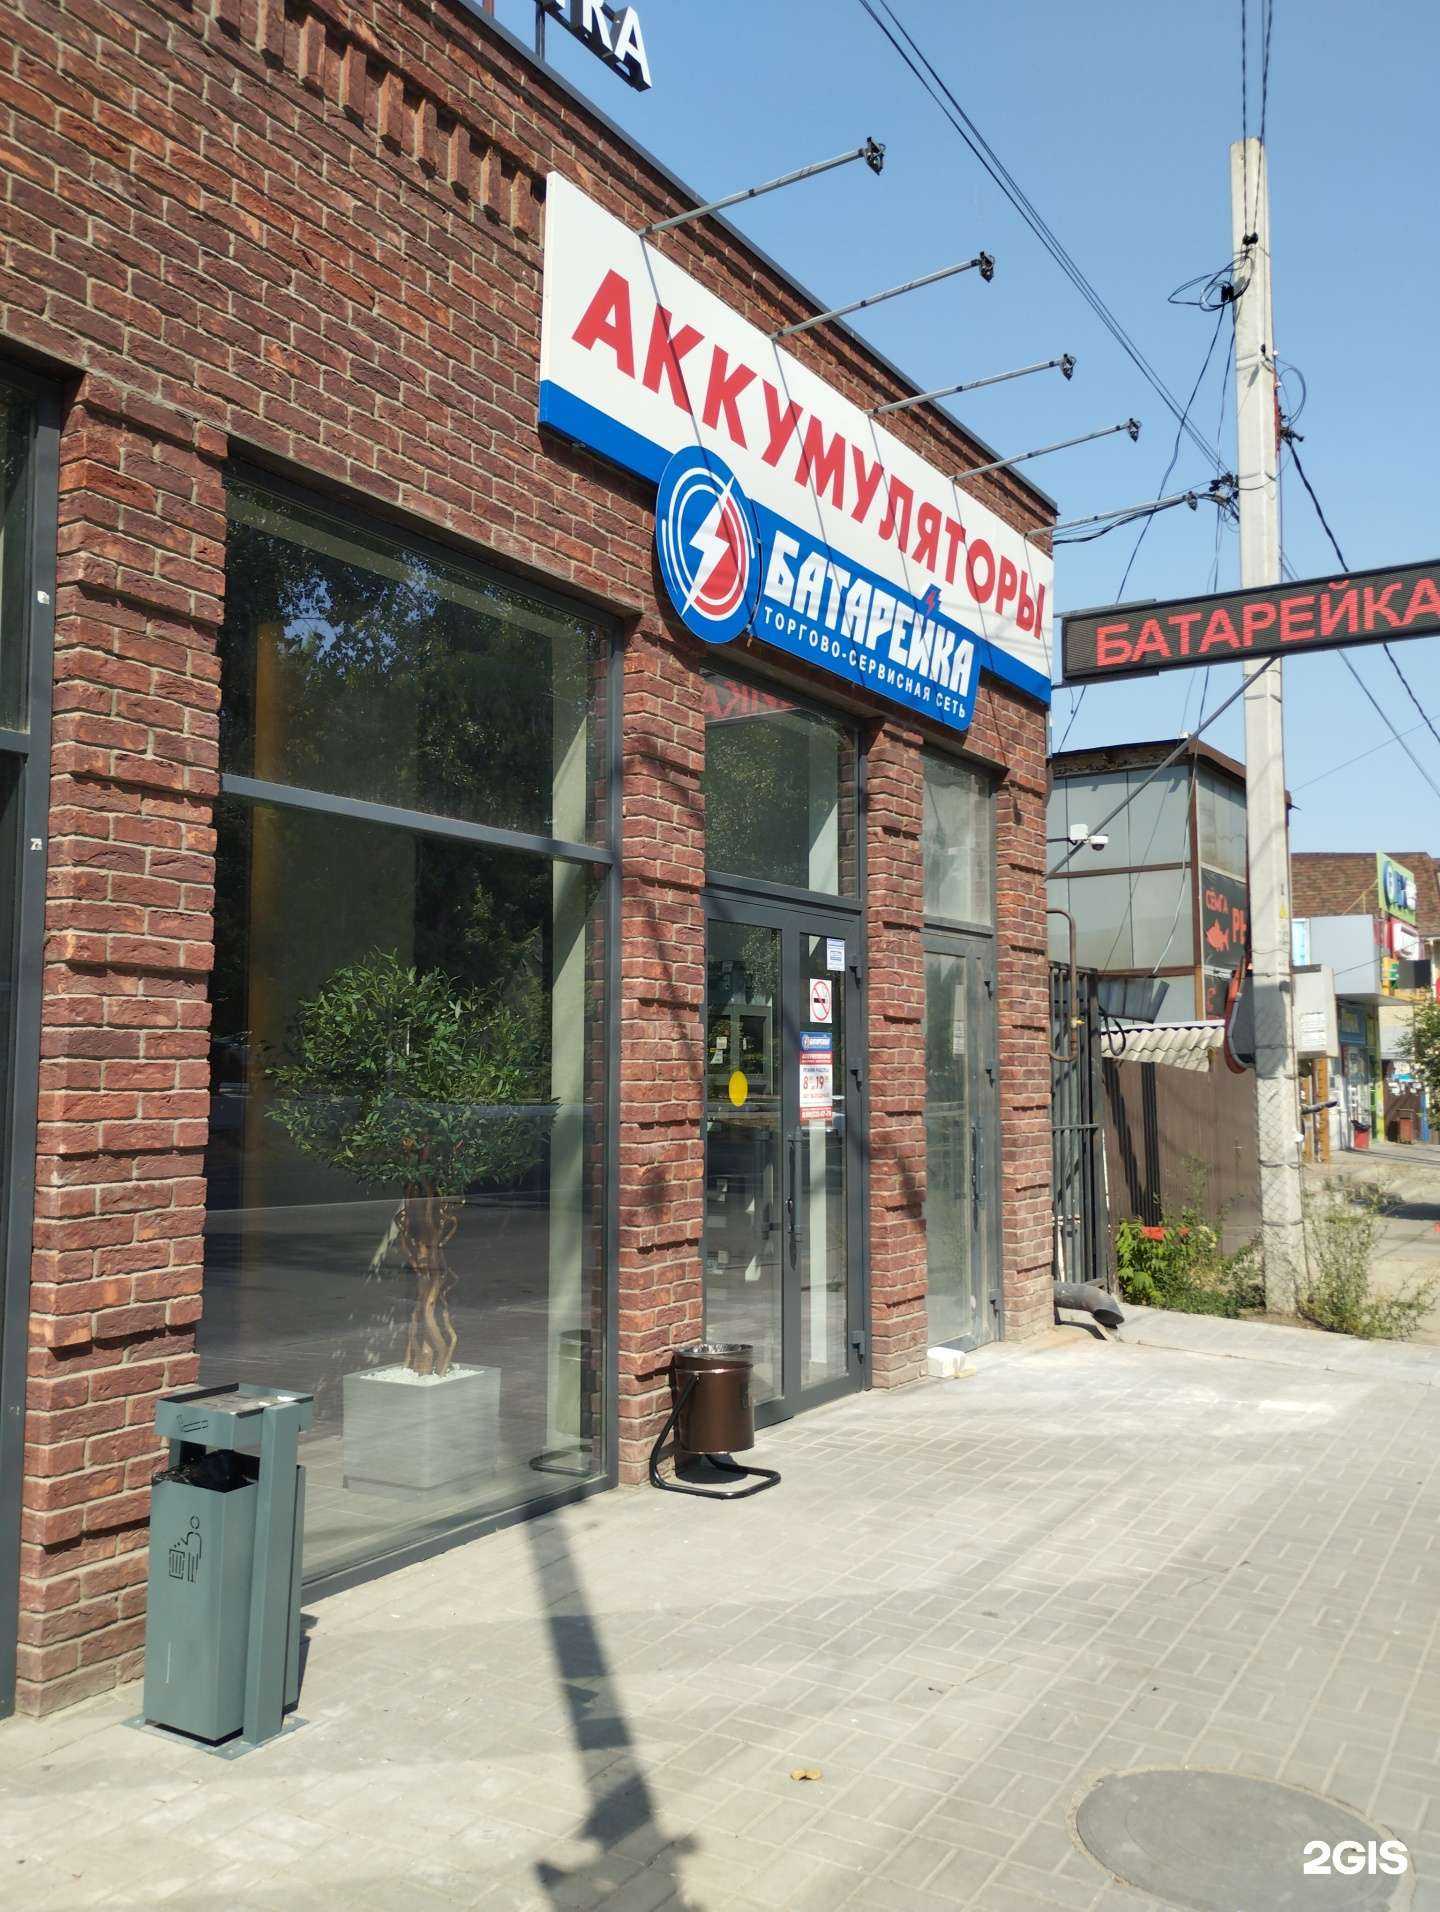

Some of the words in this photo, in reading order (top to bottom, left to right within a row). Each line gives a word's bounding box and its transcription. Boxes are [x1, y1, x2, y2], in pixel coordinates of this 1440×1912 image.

[571, 269, 1046, 641] АККУМУЛЯТОРЫ
[764, 530, 975, 697] БАТАРЕЙКА
[764, 606, 931, 702] ТОРГОВО-СЕРВИСНАЯ
[935, 692, 966, 719] СЕТЬ
[1096, 578, 1440, 667] БАТАРЕЙКА
